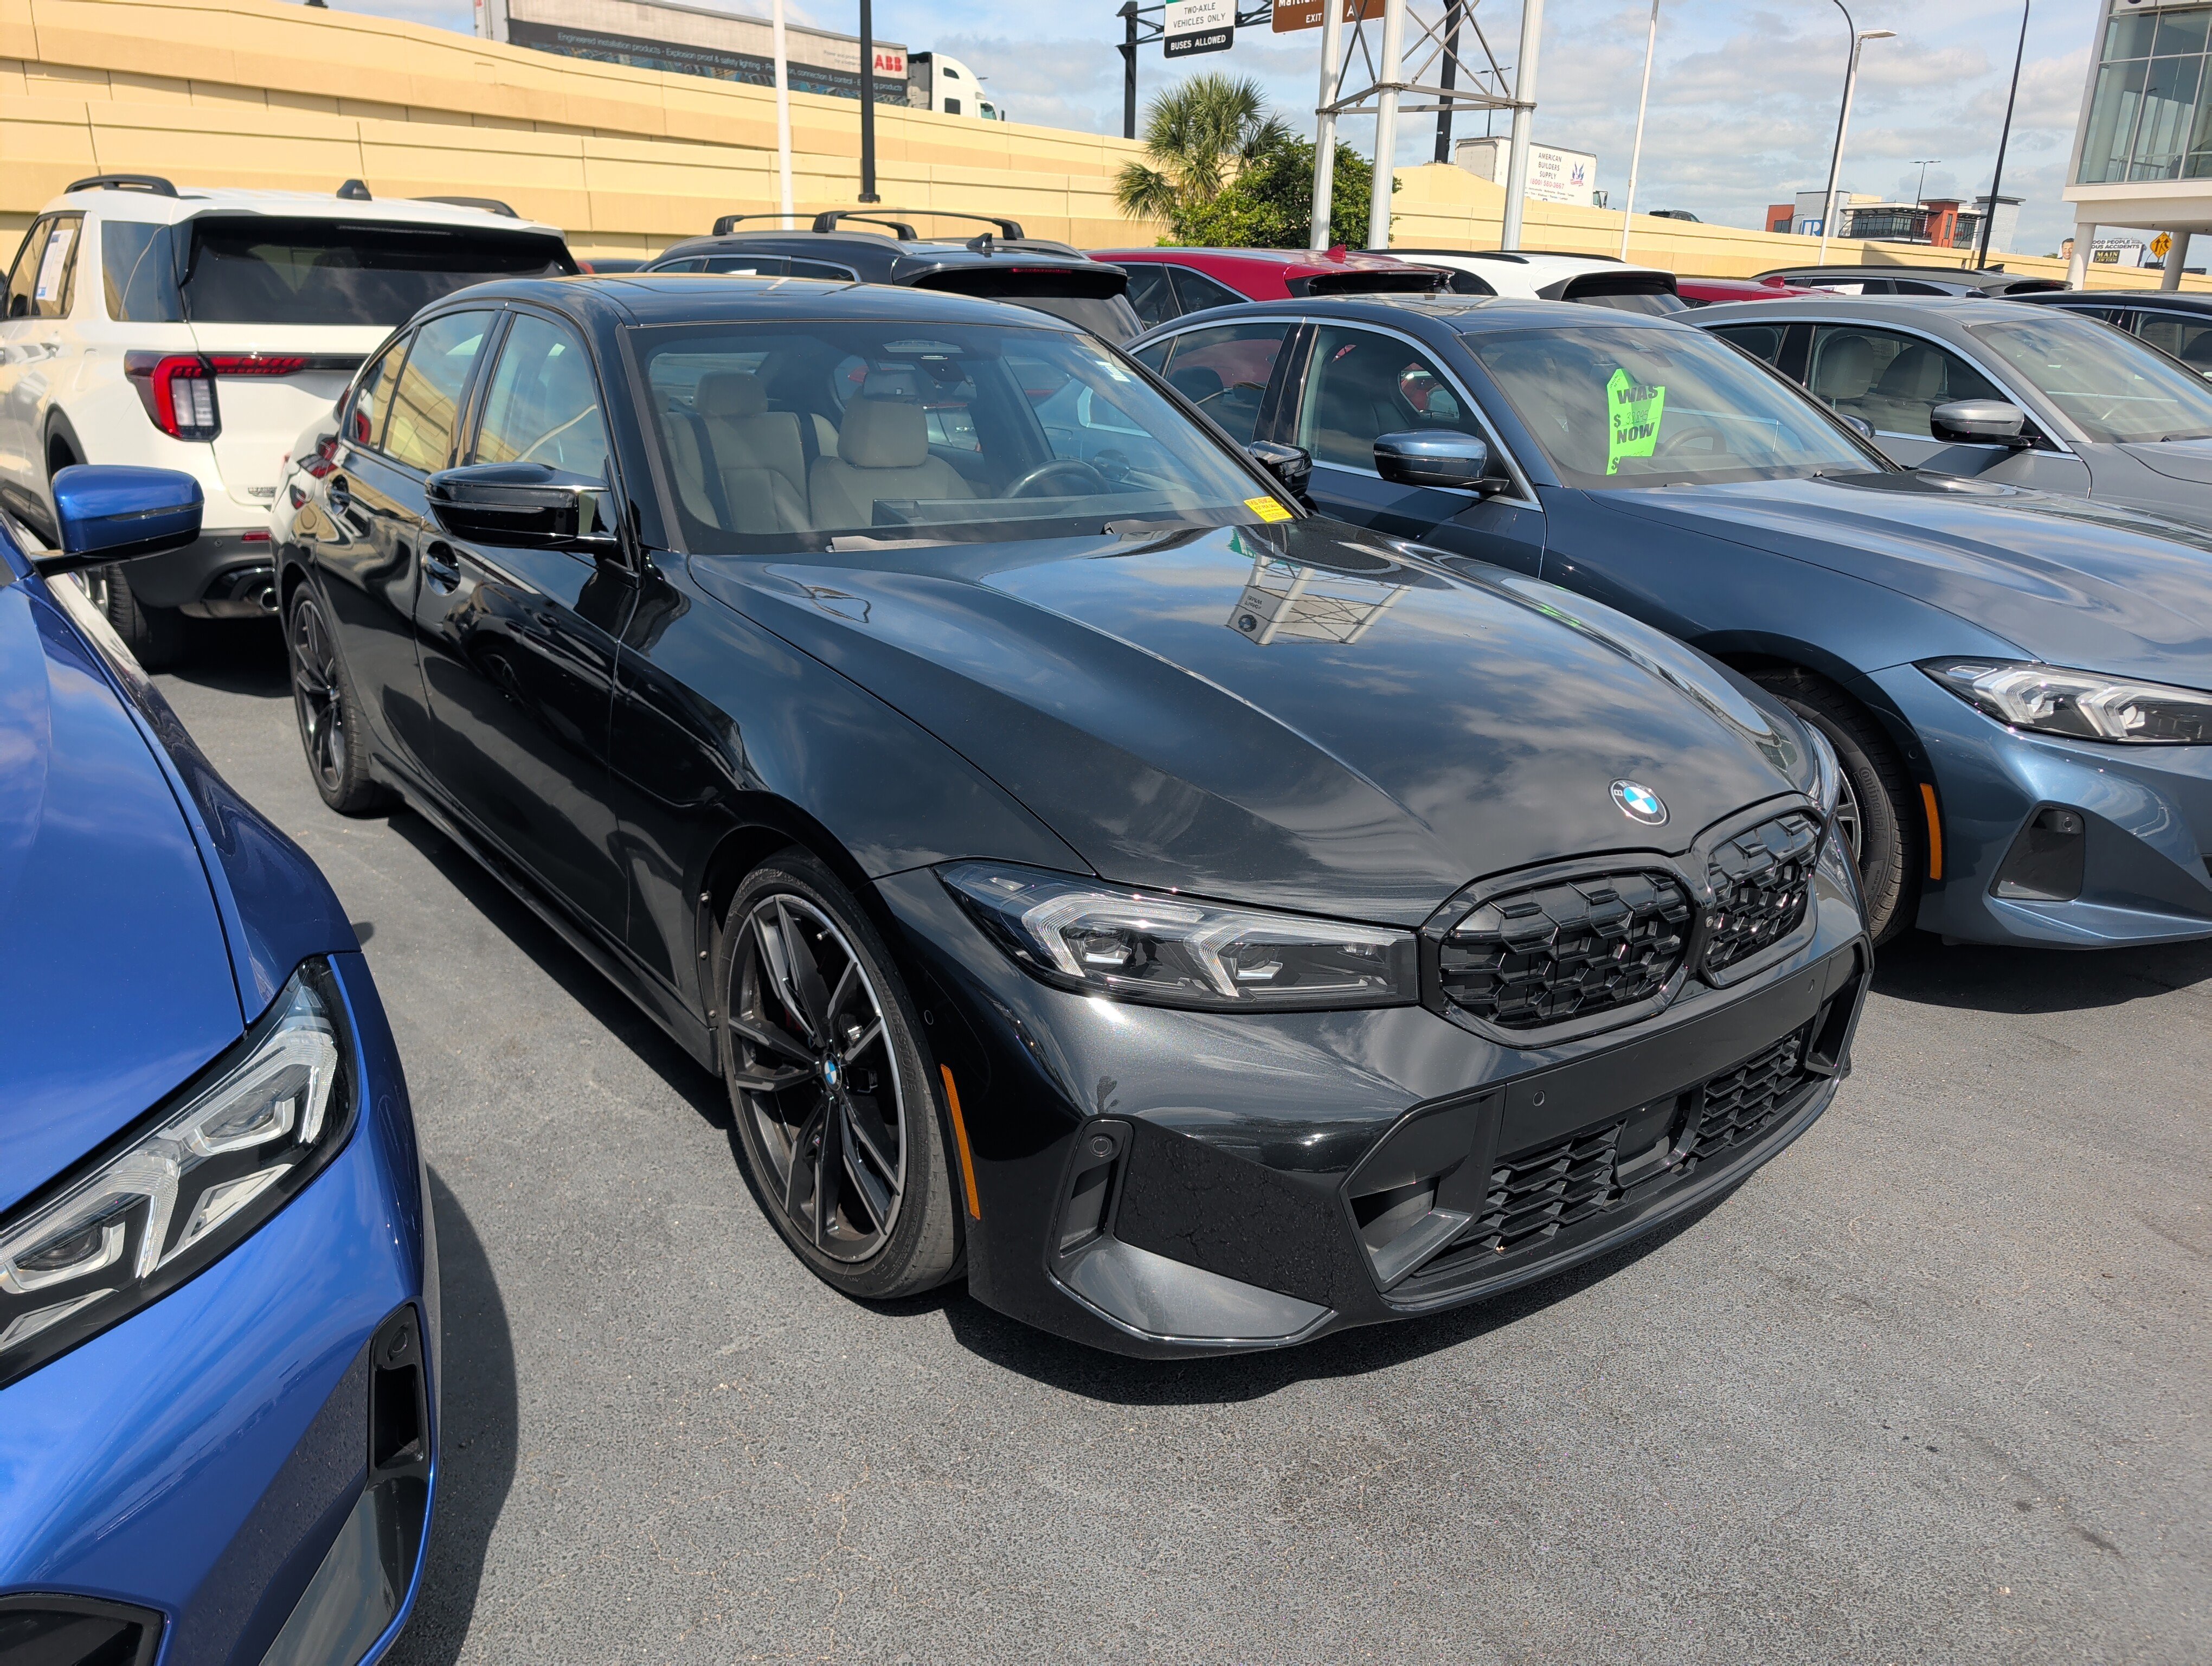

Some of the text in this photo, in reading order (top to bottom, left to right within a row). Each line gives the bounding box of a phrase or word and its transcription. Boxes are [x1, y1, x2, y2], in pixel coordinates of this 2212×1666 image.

[1184, 2, 1216, 15] TWO-AXLE
[1173, 12, 1226, 28] VEHICLES ONLY
[1306, 12, 1322, 23] EXIT
[557, 31, 596, 44] Engineered
[632, 43, 661, 55] products
[666, 47, 696, 58] Explosion
[714, 55, 719, 63] &
[1171, 35, 1226, 50] BUSES ALLOWED
[874, 54, 903, 72] ABB
[879, 83, 903, 92] products
[1538, 152, 1562, 162] AMERICAN
[1538, 162, 1560, 171] BUILDERS
[1540, 171, 1557, 180] SUPPLY
[1617, 386, 1658, 404] WAS
[1614, 413, 1621, 428] $
[1617, 422, 1655, 445] NOW
[1859, 766, 1886, 831] Continental
[873, 970, 917, 1092] BRIDGESTONE
